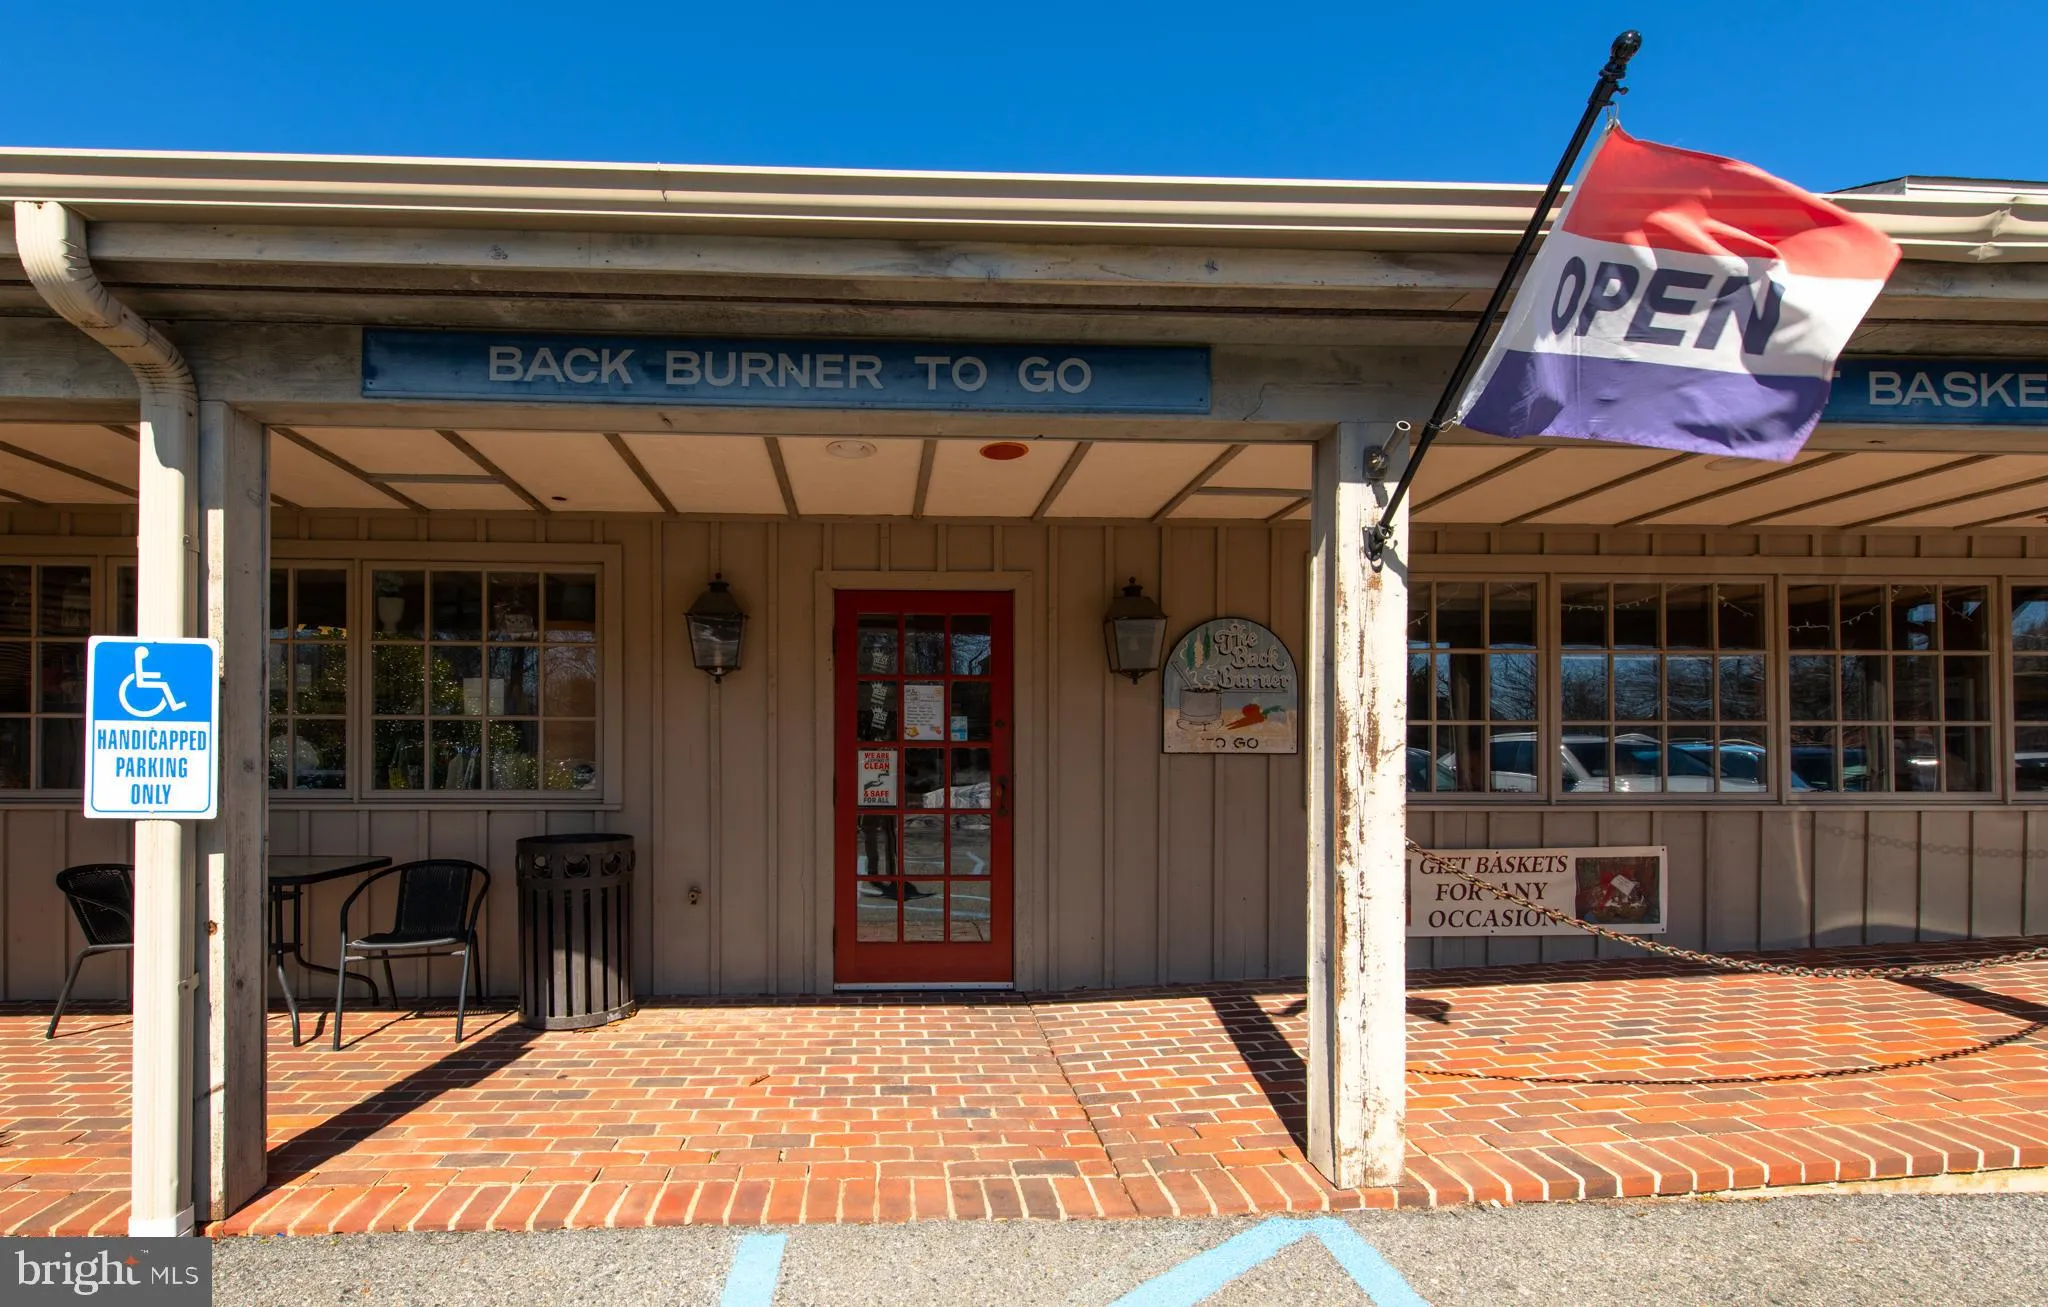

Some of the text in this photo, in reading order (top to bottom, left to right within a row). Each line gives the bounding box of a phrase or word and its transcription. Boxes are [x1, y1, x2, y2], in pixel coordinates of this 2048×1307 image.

[1551, 255, 1785, 356] OPEN
[488, 345, 1093, 394] BACK BURNER TO GO
[1869, 371, 2048, 408] BASKE
[1213, 623, 1258, 655] The
[1231, 645, 1287, 671] Back
[1217, 667, 1291, 690] Burner
[97, 729, 207, 751] HANDICAPPED
[1233, 737, 1258, 749] GO
[116, 757, 188, 778] PARKING
[131, 783, 172, 805] ONLY
[1475, 855, 1568, 874] BASKETS
[1435, 882, 1548, 901] FOR ANY
[1428, 908, 1560, 928] OCCASION
